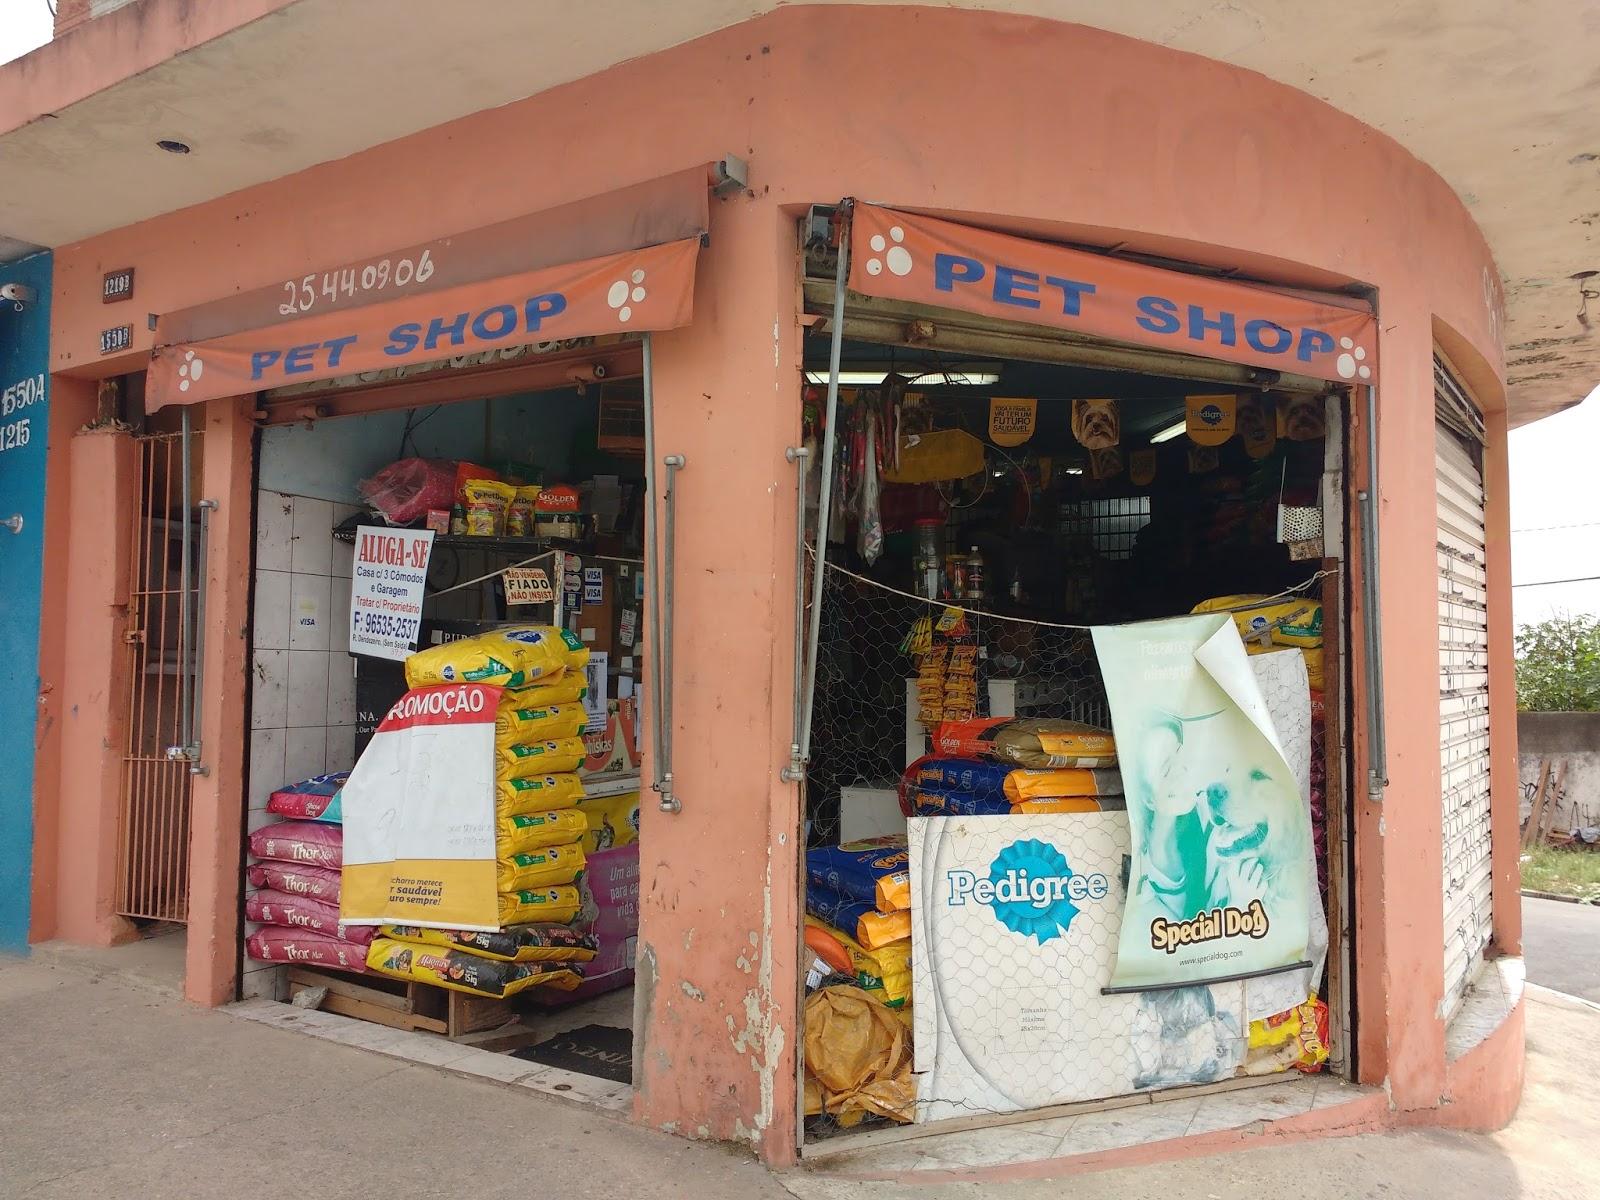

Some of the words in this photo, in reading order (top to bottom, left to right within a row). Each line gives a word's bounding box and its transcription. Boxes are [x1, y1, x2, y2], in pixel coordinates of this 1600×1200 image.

[934, 253, 1096, 317] PET
[1136, 296, 1336, 362] SHOP
[250, 335, 358, 380] PET
[383, 292, 567, 357] SHOP
[2, 373, 45, 416] 1550A
[993, 417, 1031, 425] FUTURO
[0, 419, 30, 450] 1215
[513, 497, 536, 506] etDog
[538, 491, 576, 503] GOLDEN
[358, 533, 429, 569] ALUGA-SE
[356, 566, 375, 578] Casa
[384, 569, 389, 580] 3
[390, 568, 424, 584] Cômodos
[586, 570, 602, 580] VISA
[370, 583, 375, 593] e
[376, 583, 408, 597] Garagem
[508, 579, 549, 590] FIADO
[586, 588, 601, 598] VISA
[511, 590, 528, 600] NÃO
[356, 596, 375, 609] Tratar
[382, 599, 420, 615] Proprietário
[300, 618, 315, 626] VISA
[353, 611, 363, 632] F:
[365, 613, 418, 640] 96535-2537
[387, 685, 484, 720] ROMOÇÃO
[357, 711, 379, 722] NA.
[585, 738, 613, 755] hiskas
[291, 842, 319, 860] Thor
[610, 866, 624, 881] Um
[283, 874, 310, 891] Thor
[416, 879, 443, 887] merece
[947, 868, 1109, 909] Pedigree
[396, 886, 443, 897] saudável
[610, 885, 628, 904] para
[389, 895, 405, 903] uro
[406, 896, 442, 906] sempre!
[617, 901, 634, 917] vida
[283, 908, 310, 925] Thor
[1151, 910, 1222, 954] Special
[1224, 899, 1269, 939] Dog
[283, 943, 310, 960] Thor
[1179, 949, 1244, 967] www.specialdog.com
